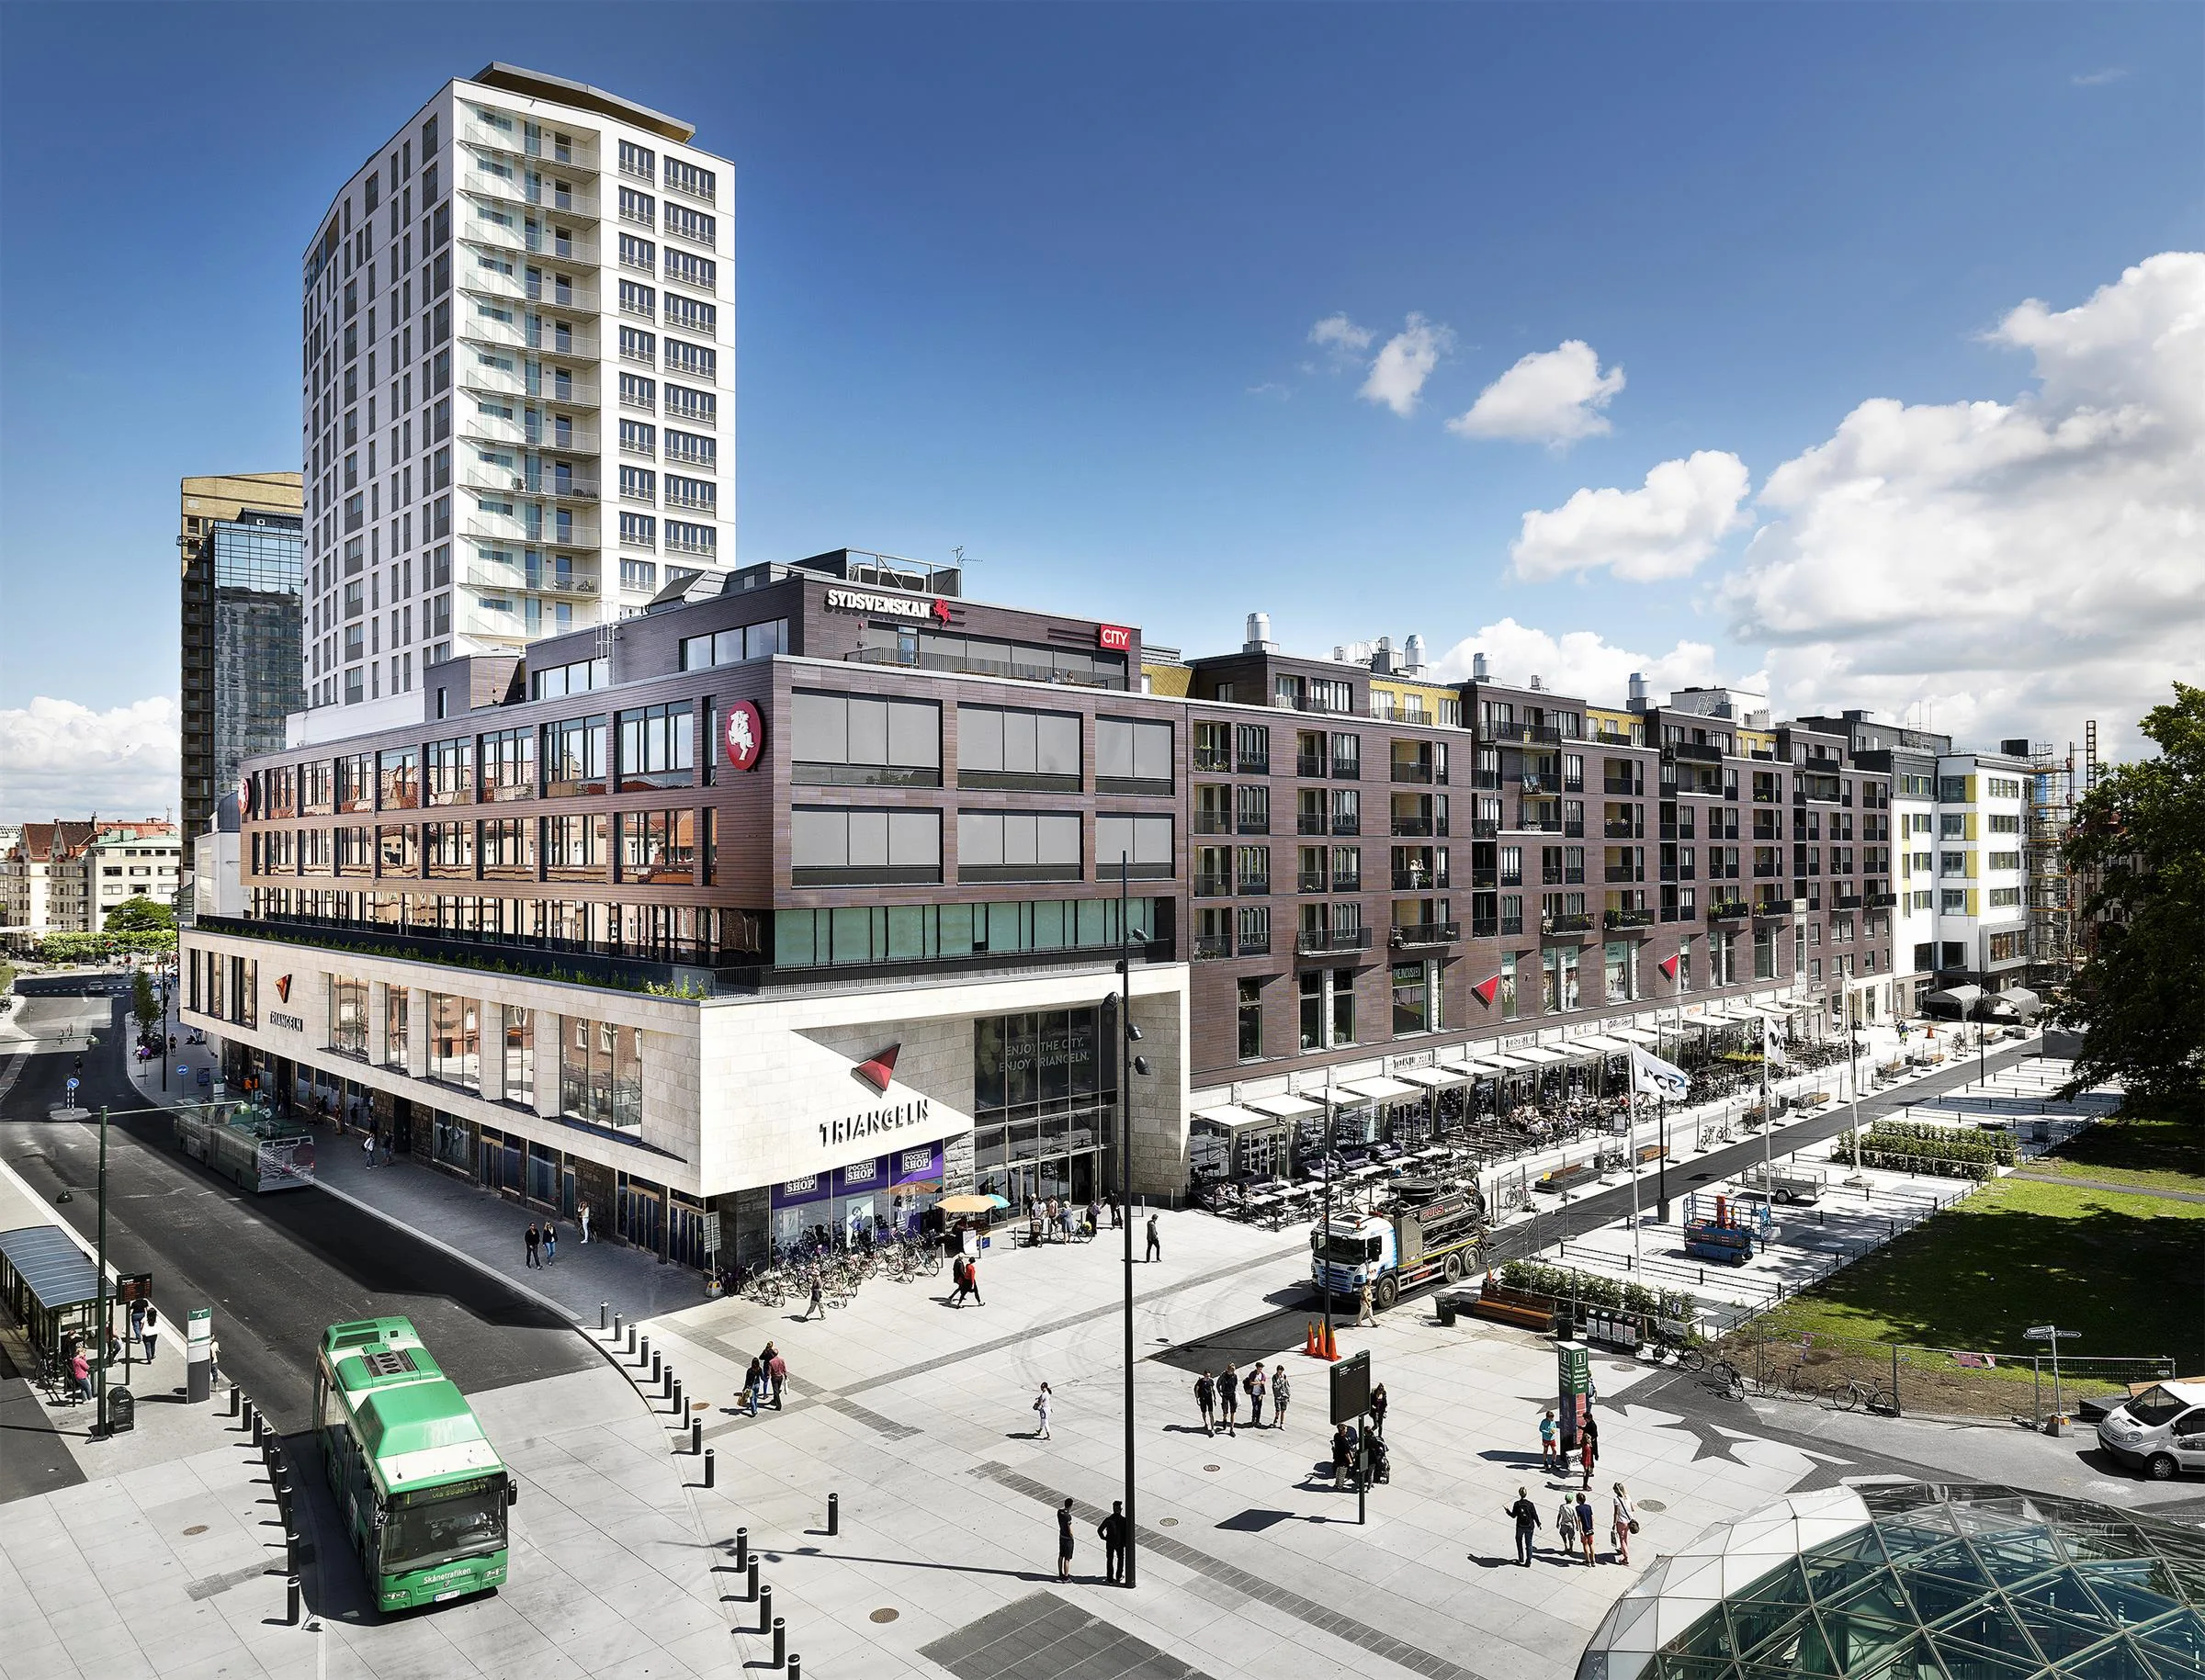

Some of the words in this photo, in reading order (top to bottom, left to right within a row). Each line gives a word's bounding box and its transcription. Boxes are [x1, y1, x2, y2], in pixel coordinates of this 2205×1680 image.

[828, 589, 931, 618] SYDSVENSKAN
[1102, 629, 1128, 646] CITY
[1006, 1043, 1037, 1057] ENJOY
[1040, 1040, 1059, 1052] THE
[1061, 1037, 1084, 1049] CTY.
[999, 1058, 1032, 1073] ENJOY
[820, 1099, 929, 1147] TRIANGELN
[904, 1157, 929, 1171] SHOP
[905, 1152, 929, 1161] POCKET
[848, 1162, 874, 1172] POCKET
[847, 1169, 874, 1182] SHOP
[786, 1178, 815, 1193] SHOP
[1422, 1204, 1445, 1220] PULS
[424, 1567, 471, 1584] Skånetrafiken
